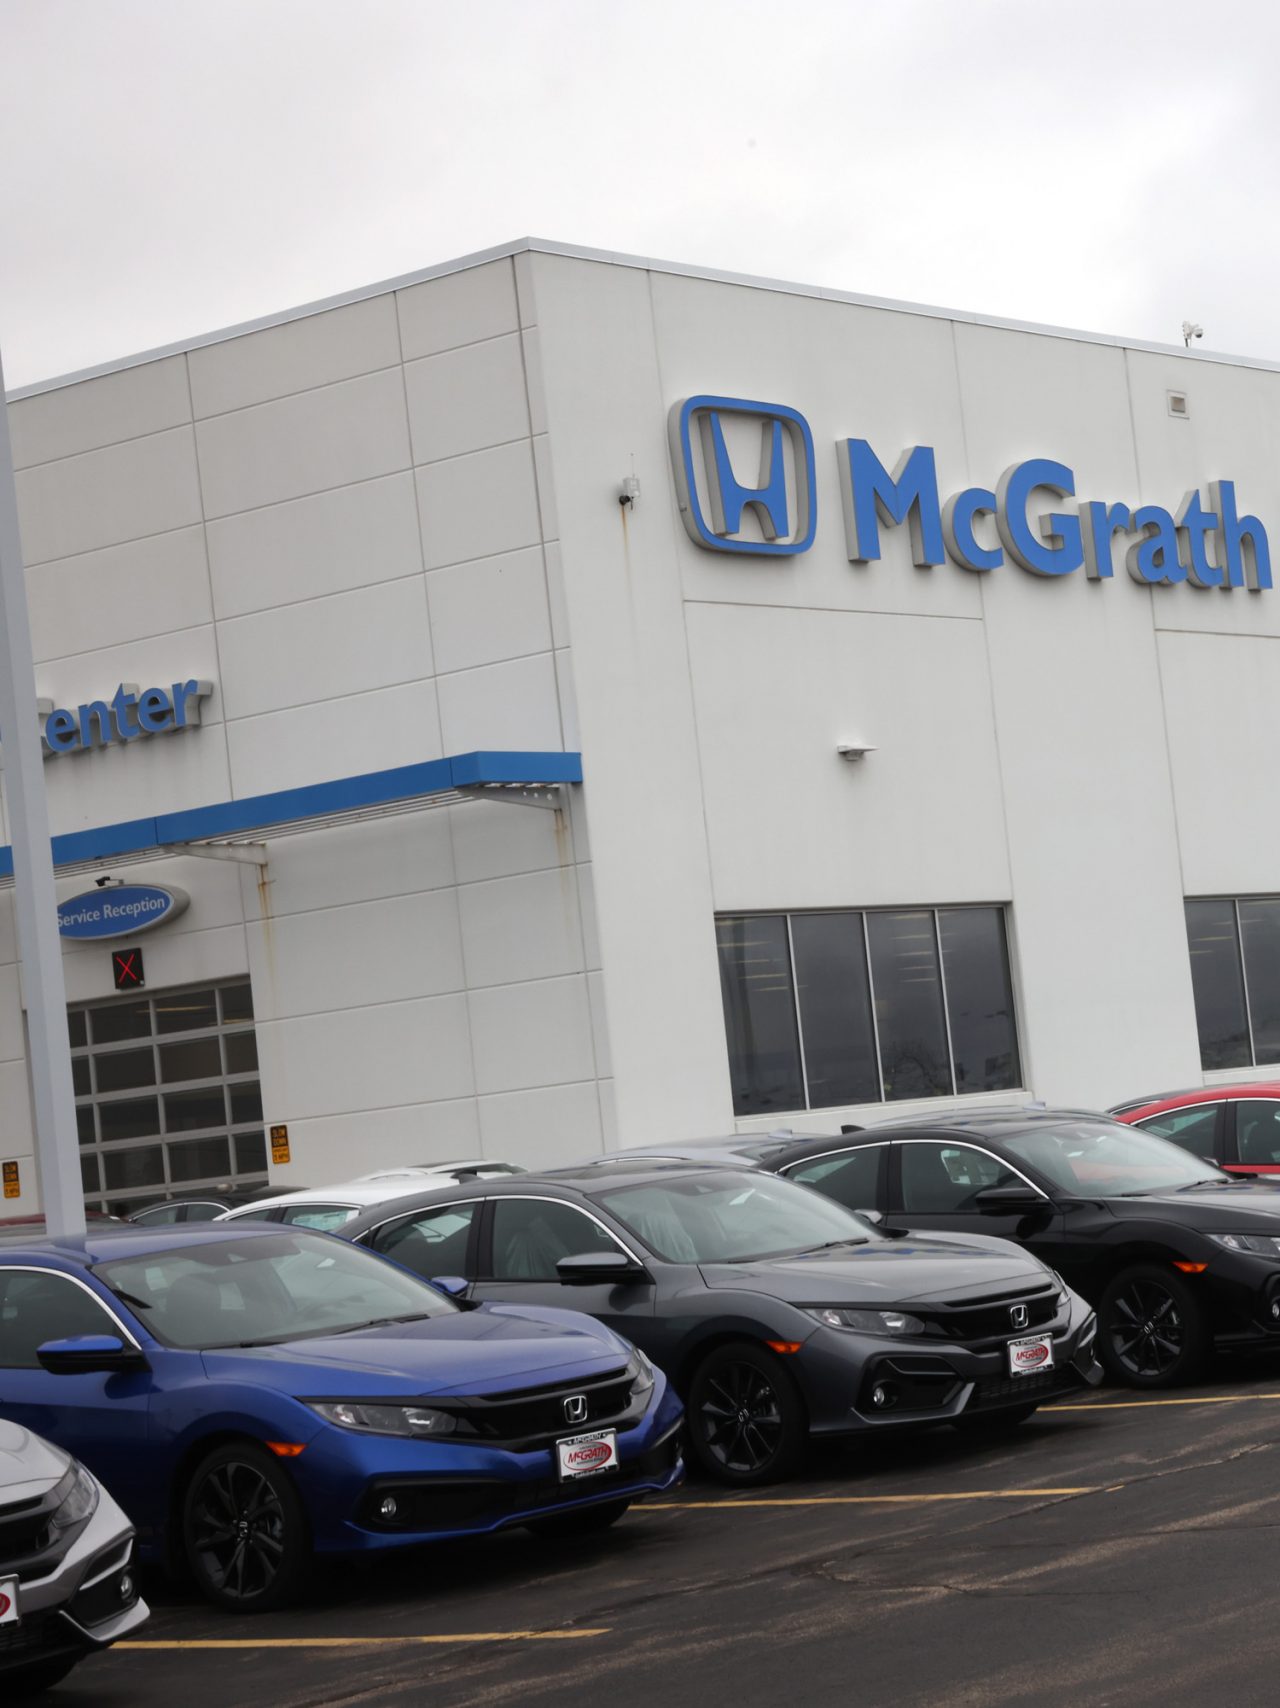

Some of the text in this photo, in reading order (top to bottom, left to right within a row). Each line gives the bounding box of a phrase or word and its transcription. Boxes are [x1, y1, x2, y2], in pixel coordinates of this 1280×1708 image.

[836, 438, 1272, 590] McGrath
[42, 679, 206, 753] enter
[103, 897, 166, 919] Reception
[568, 1446, 608, 1463] McGRATH
